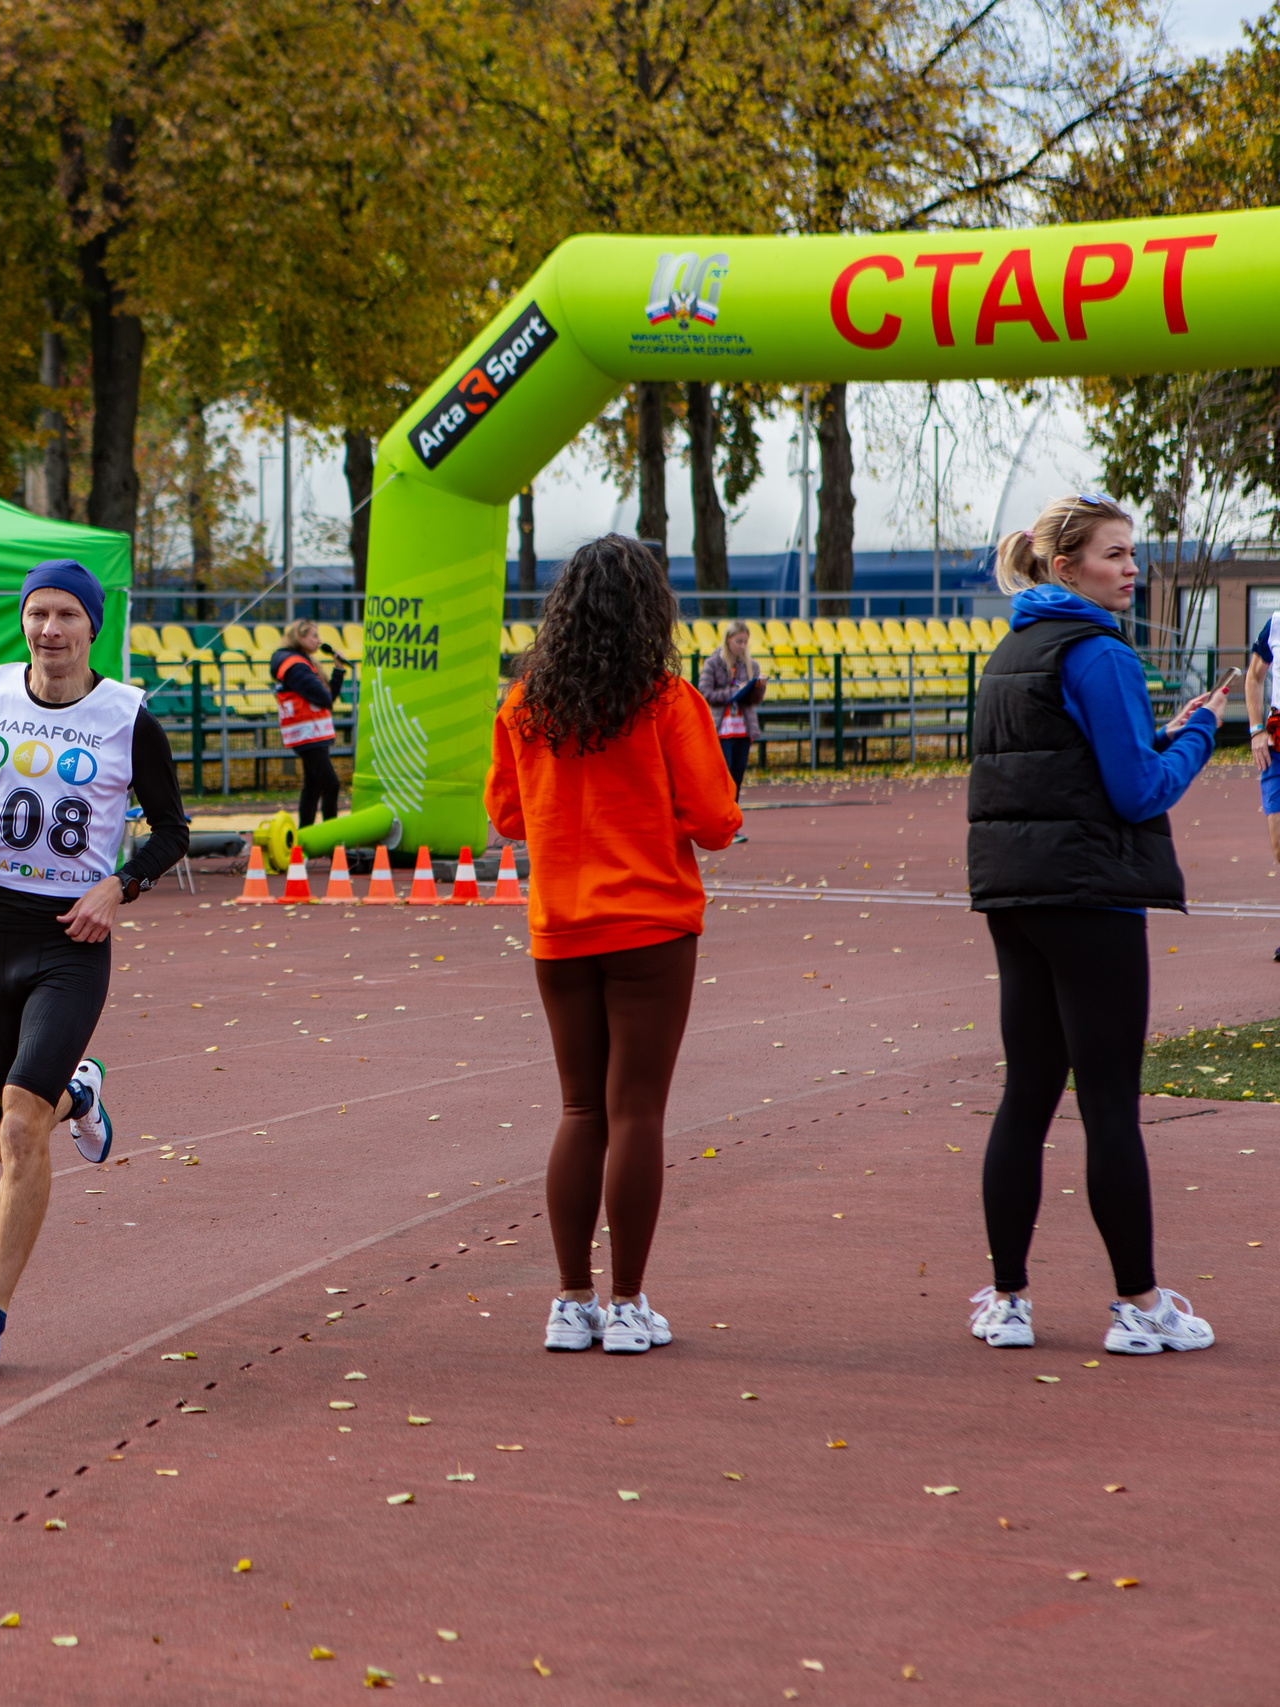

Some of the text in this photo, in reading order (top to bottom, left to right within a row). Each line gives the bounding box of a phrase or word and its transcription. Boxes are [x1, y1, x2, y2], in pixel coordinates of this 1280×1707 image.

[830, 234, 1218, 350] СТАРТ
[629, 344, 753, 356] РОССИЙСКОЙ ФЕДЕРАЦИИ
[631, 333, 745, 345] МИНИСТЕРСТВО СПОРТА
[418, 315, 548, 459] Arta Sport
[367, 596, 424, 620] СПОРТ
[365, 620, 439, 647] НОРМА
[364, 645, 438, 672] ЖИЗНИ
